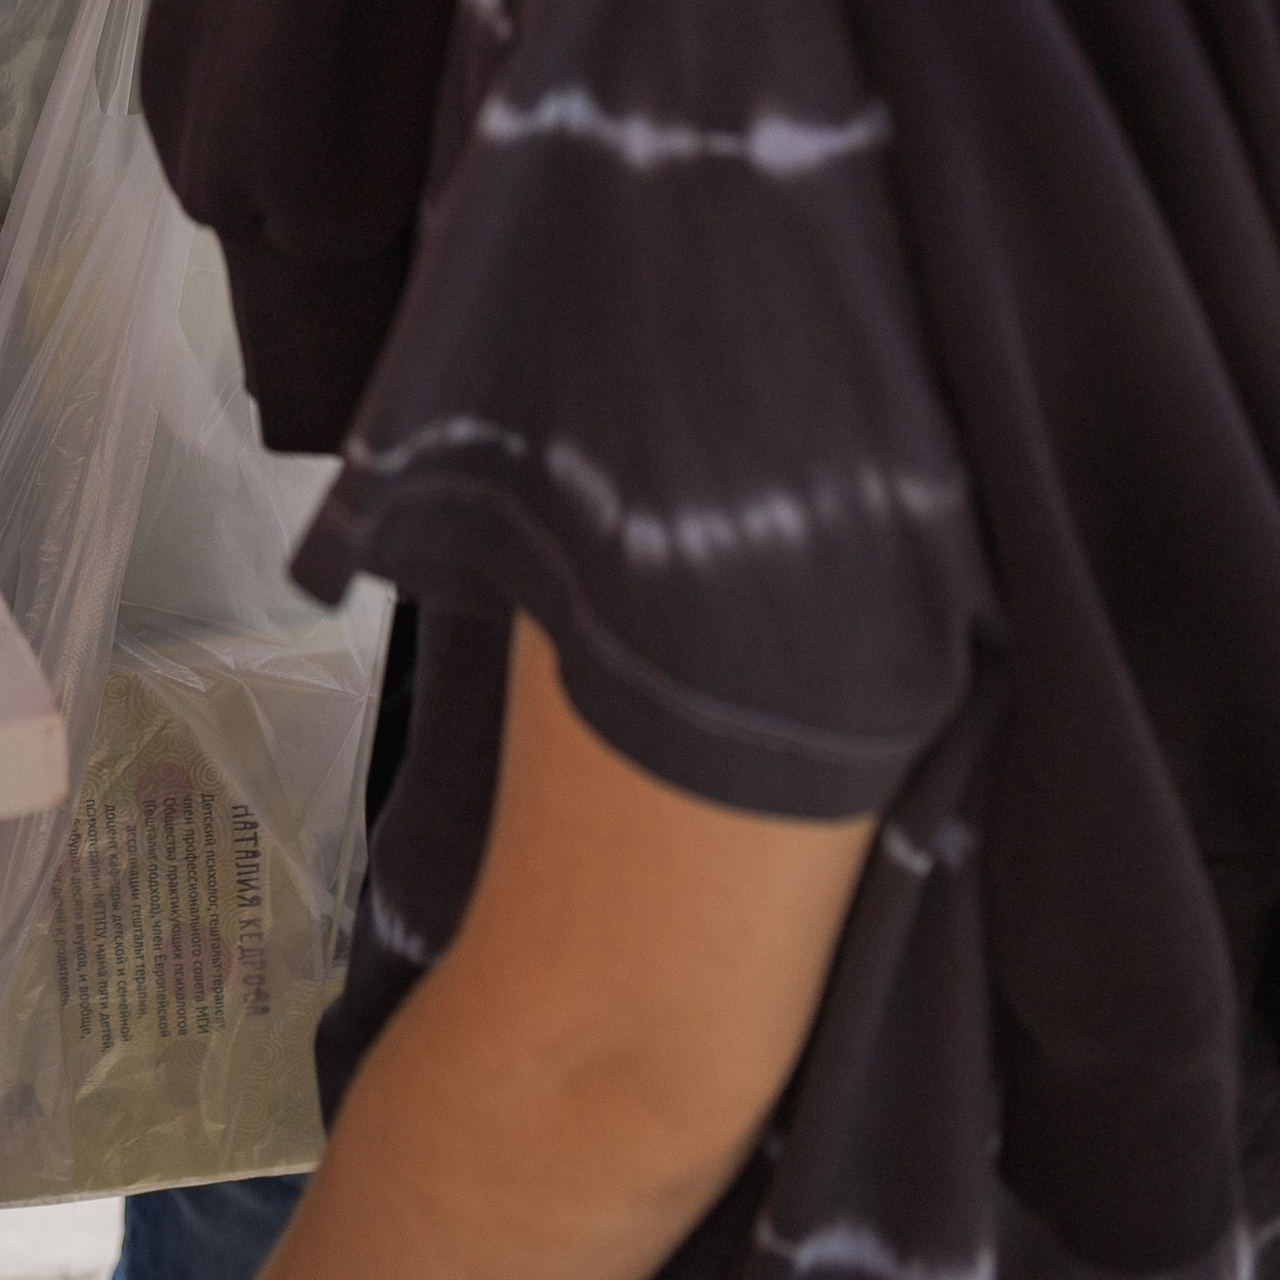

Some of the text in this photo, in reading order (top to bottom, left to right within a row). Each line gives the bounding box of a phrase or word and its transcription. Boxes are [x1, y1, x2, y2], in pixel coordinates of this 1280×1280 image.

[85, 799, 102, 890] психотерапии
[200, 793, 218, 847] Детский
[231, 805, 262, 909] НАТАЛИЯ
[142, 799, 170, 1038] (Гештальт подход), член Европейской
[162, 797, 189, 1036] Общества практикующих психологов
[182, 794, 210, 1034] член профессионального совета МГИ
[204, 850, 218, 911] психолог,
[73, 924, 88, 972] внуков,
[104, 803, 132, 1042] доцент кафедры детской и семейной
[125, 824, 149, 1020] ассоциации гештальт терапии,
[96, 944, 107, 978] мама
[97, 981, 109, 1010] пяти
[77, 986, 94, 1039] вообще,
[98, 1012, 114, 1053] детей,
